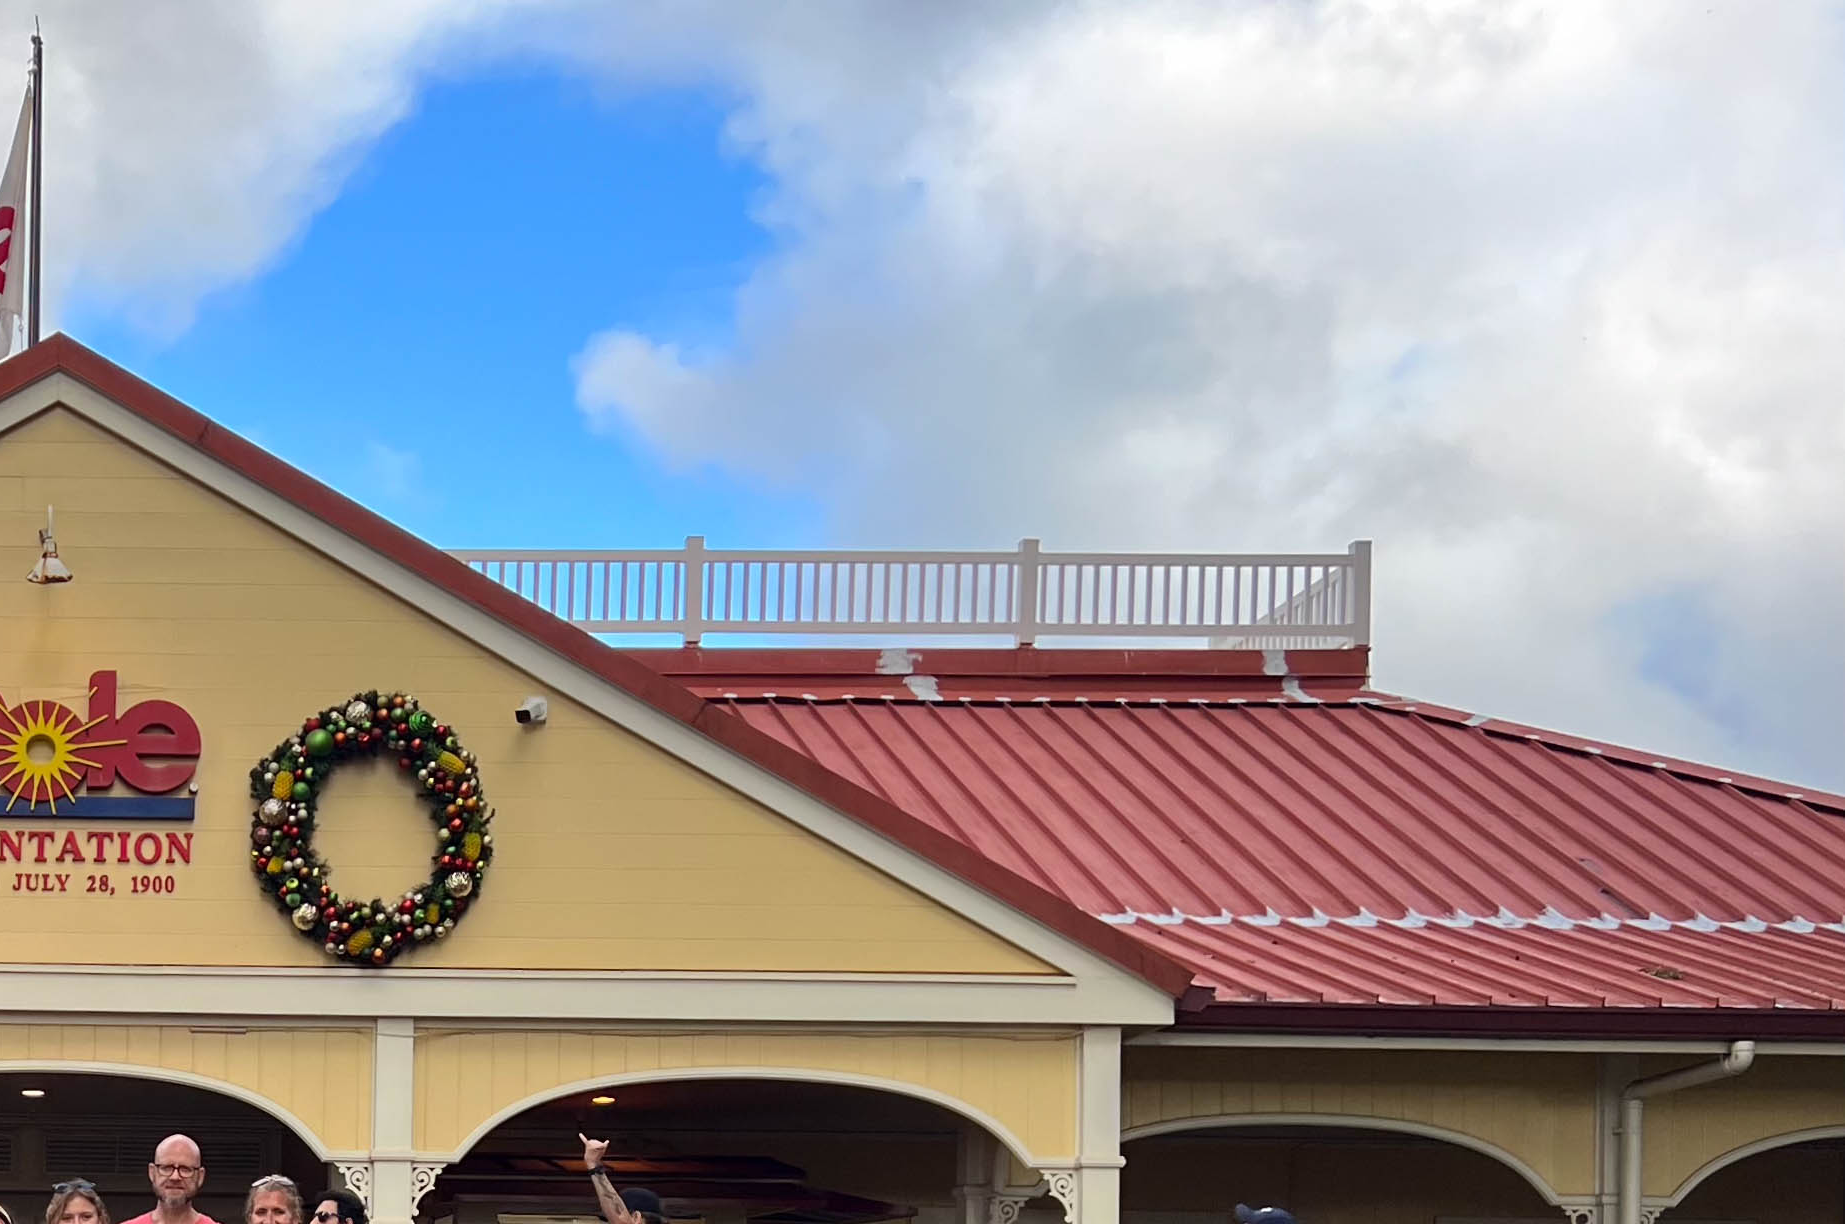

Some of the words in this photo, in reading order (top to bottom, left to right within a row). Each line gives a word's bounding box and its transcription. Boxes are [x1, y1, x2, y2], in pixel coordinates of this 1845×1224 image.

[12, 873, 71, 893] JULY
[86, 874, 116, 896] 28,
[131, 875, 175, 894] 1900
